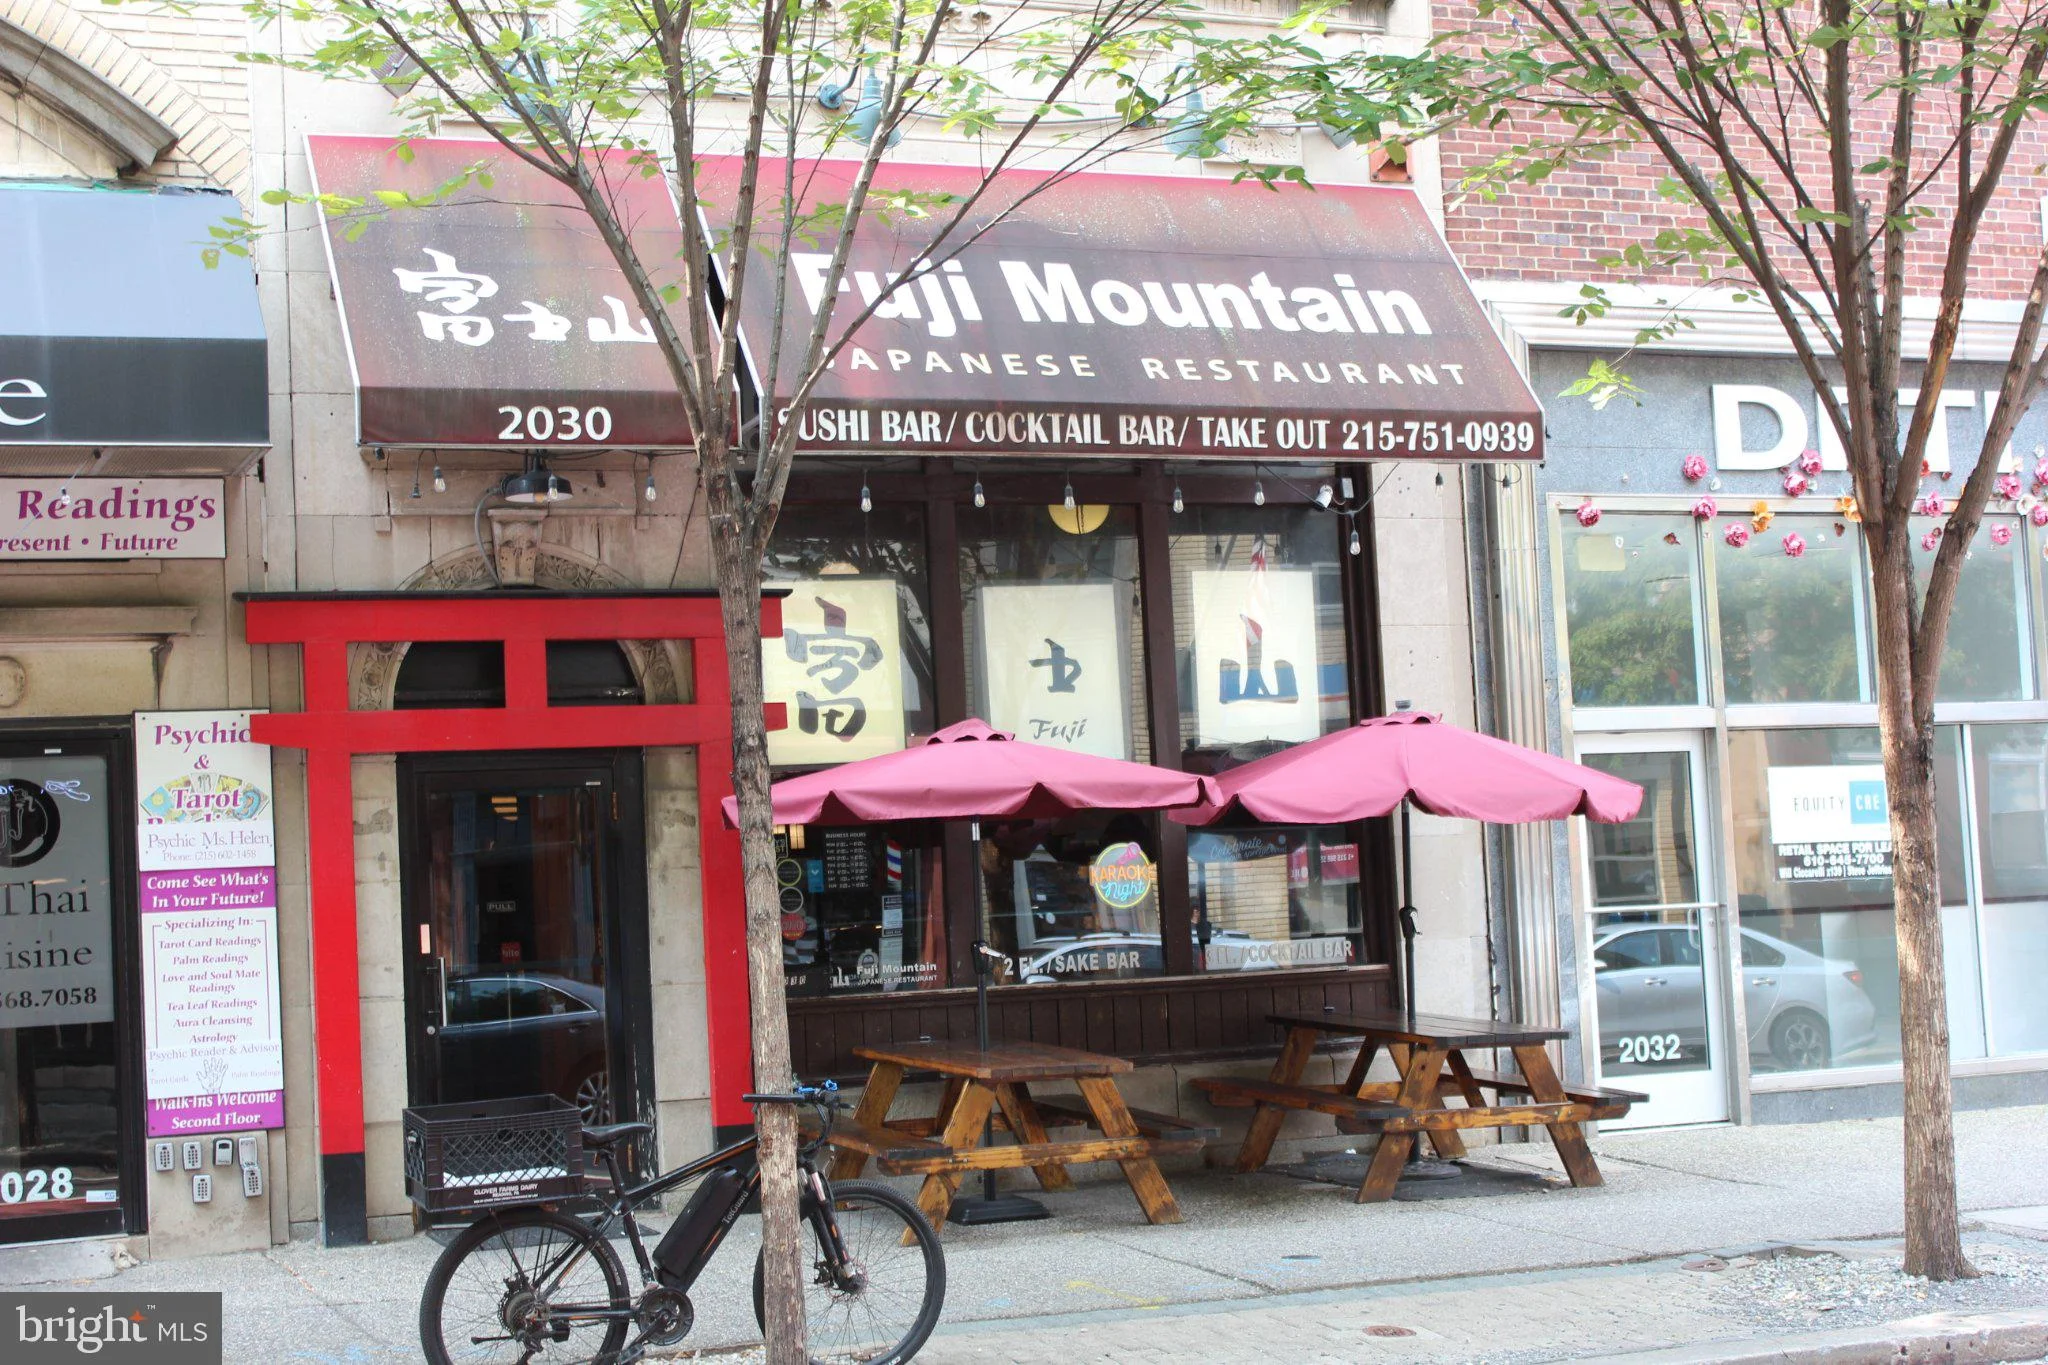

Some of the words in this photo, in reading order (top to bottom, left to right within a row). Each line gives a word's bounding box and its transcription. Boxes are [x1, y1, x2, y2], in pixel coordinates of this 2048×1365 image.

[790, 252, 983, 338] Fuji
[998, 260, 1433, 335] Mountain
[1140, 357, 1465, 385] RESTAURANT
[498, 406, 612, 441] 2030
[965, 411, 1110, 445] COCKTAIL
[1197, 416, 1268, 449] TAKE
[1276, 418, 1331, 450] OUT
[1342, 420, 1535, 452] 215-751-0939
[18, 486, 216, 532] Readings
[100, 532, 178, 552] Future
[155, 721, 251, 753] Psychic
[1029, 718, 1091, 741] Fuji
[193, 754, 210, 770] &
[172, 788, 242, 810] Tarot
[1855, 793, 1880, 811] CRE
[148, 833, 196, 851] Psychic
[202, 831, 228, 847] Ms.
[230, 830, 270, 846] Helen
[1778, 843, 1814, 857] RETAIL
[1816, 842, 1850, 856] SPACE
[1851, 841, 1873, 854] FOR
[147, 876, 189, 890] Come
[193, 874, 217, 888] See
[220, 871, 269, 886] What's
[152, 895, 169, 908] In
[172, 893, 208, 907] Your
[211, 891, 264, 906] Future!
[164, 917, 235, 933] Specializing
[160, 940, 185, 950] Tarot
[188, 937, 212, 948] Card
[215, 935, 262, 949] Readings
[1323, 939, 1353, 959] BAR
[173, 955, 199, 965] Palm
[202, 953, 249, 965] Readings
[1106, 951, 1141, 970] BAR
[162, 973, 184, 983] Love
[187, 971, 207, 982] and
[210, 970, 232, 980] Soul
[235, 968, 261, 979] Mate
[857, 966, 879, 977] Fuji
[882, 962, 937, 974] Mountain
[188, 983, 236, 994] Readings
[168, 1002, 184, 1011] Tea
[187, 1000, 209, 1010] Leaf
[211, 998, 258, 1010] Readings
[174, 1018, 199, 1028] Aura
[202, 1015, 253, 1026] Cleansing
[190, 1033, 238, 1044] Astrology
[149, 1048, 187, 1061] Psychic
[190, 1046, 226, 1058] Reader
[229, 1045, 238, 1055] &
[240, 1042, 280, 1054] Advisor
[1619, 1033, 1682, 1064] 2032
[155, 1094, 214, 1111] Walk-Ins
[217, 1090, 277, 1107] Welcome
[171, 1111, 221, 1130] Second
[224, 1111, 261, 1126] Floor
